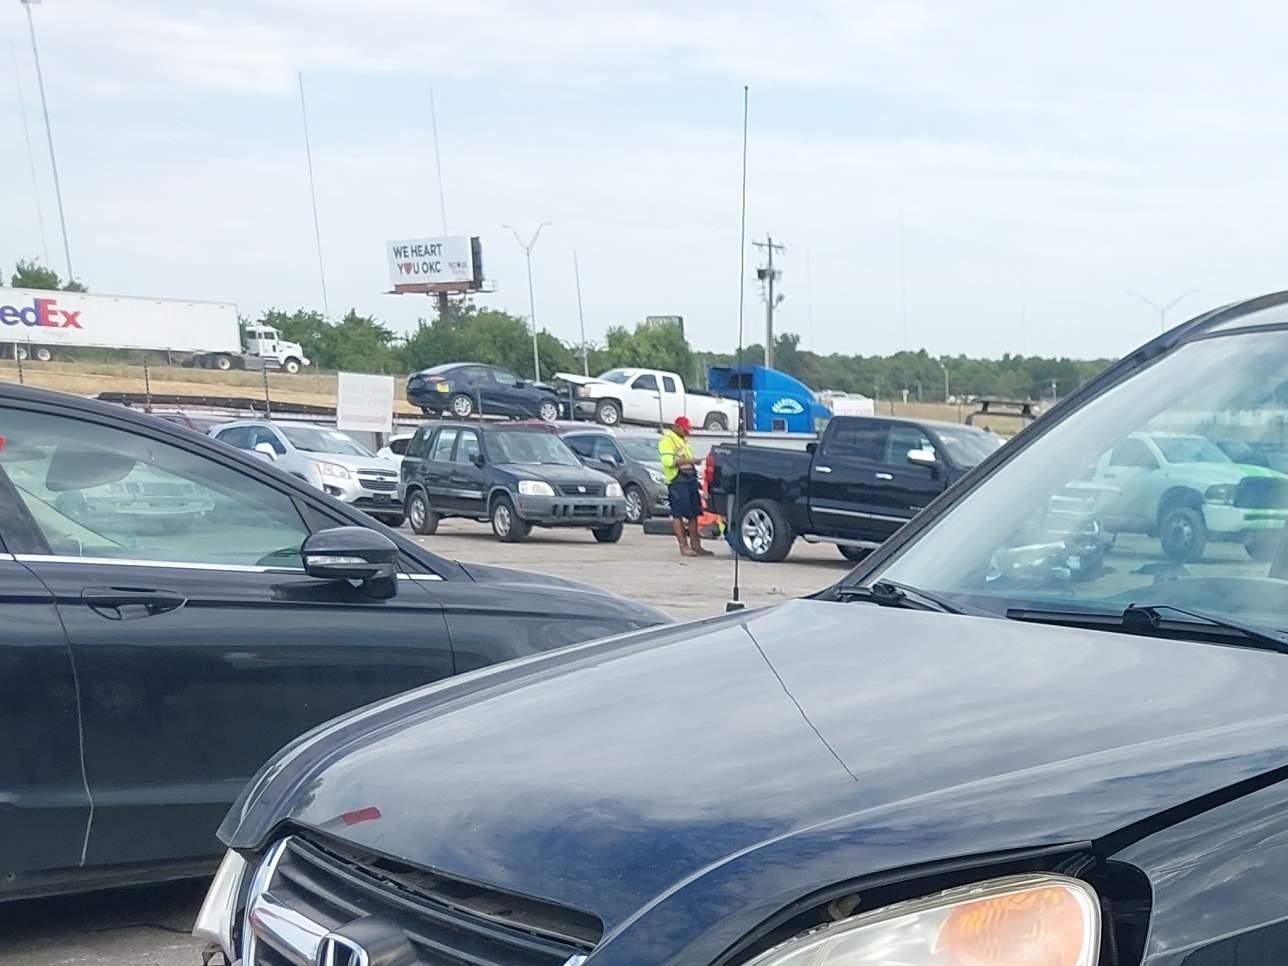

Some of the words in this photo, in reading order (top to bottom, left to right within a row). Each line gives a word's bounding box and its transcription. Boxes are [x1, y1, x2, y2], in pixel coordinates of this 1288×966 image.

[393, 245, 409, 259] WE
[410, 243, 442, 257] HEART
[421, 261, 441, 274] OKC
[0, 298, 84, 329] edEx
